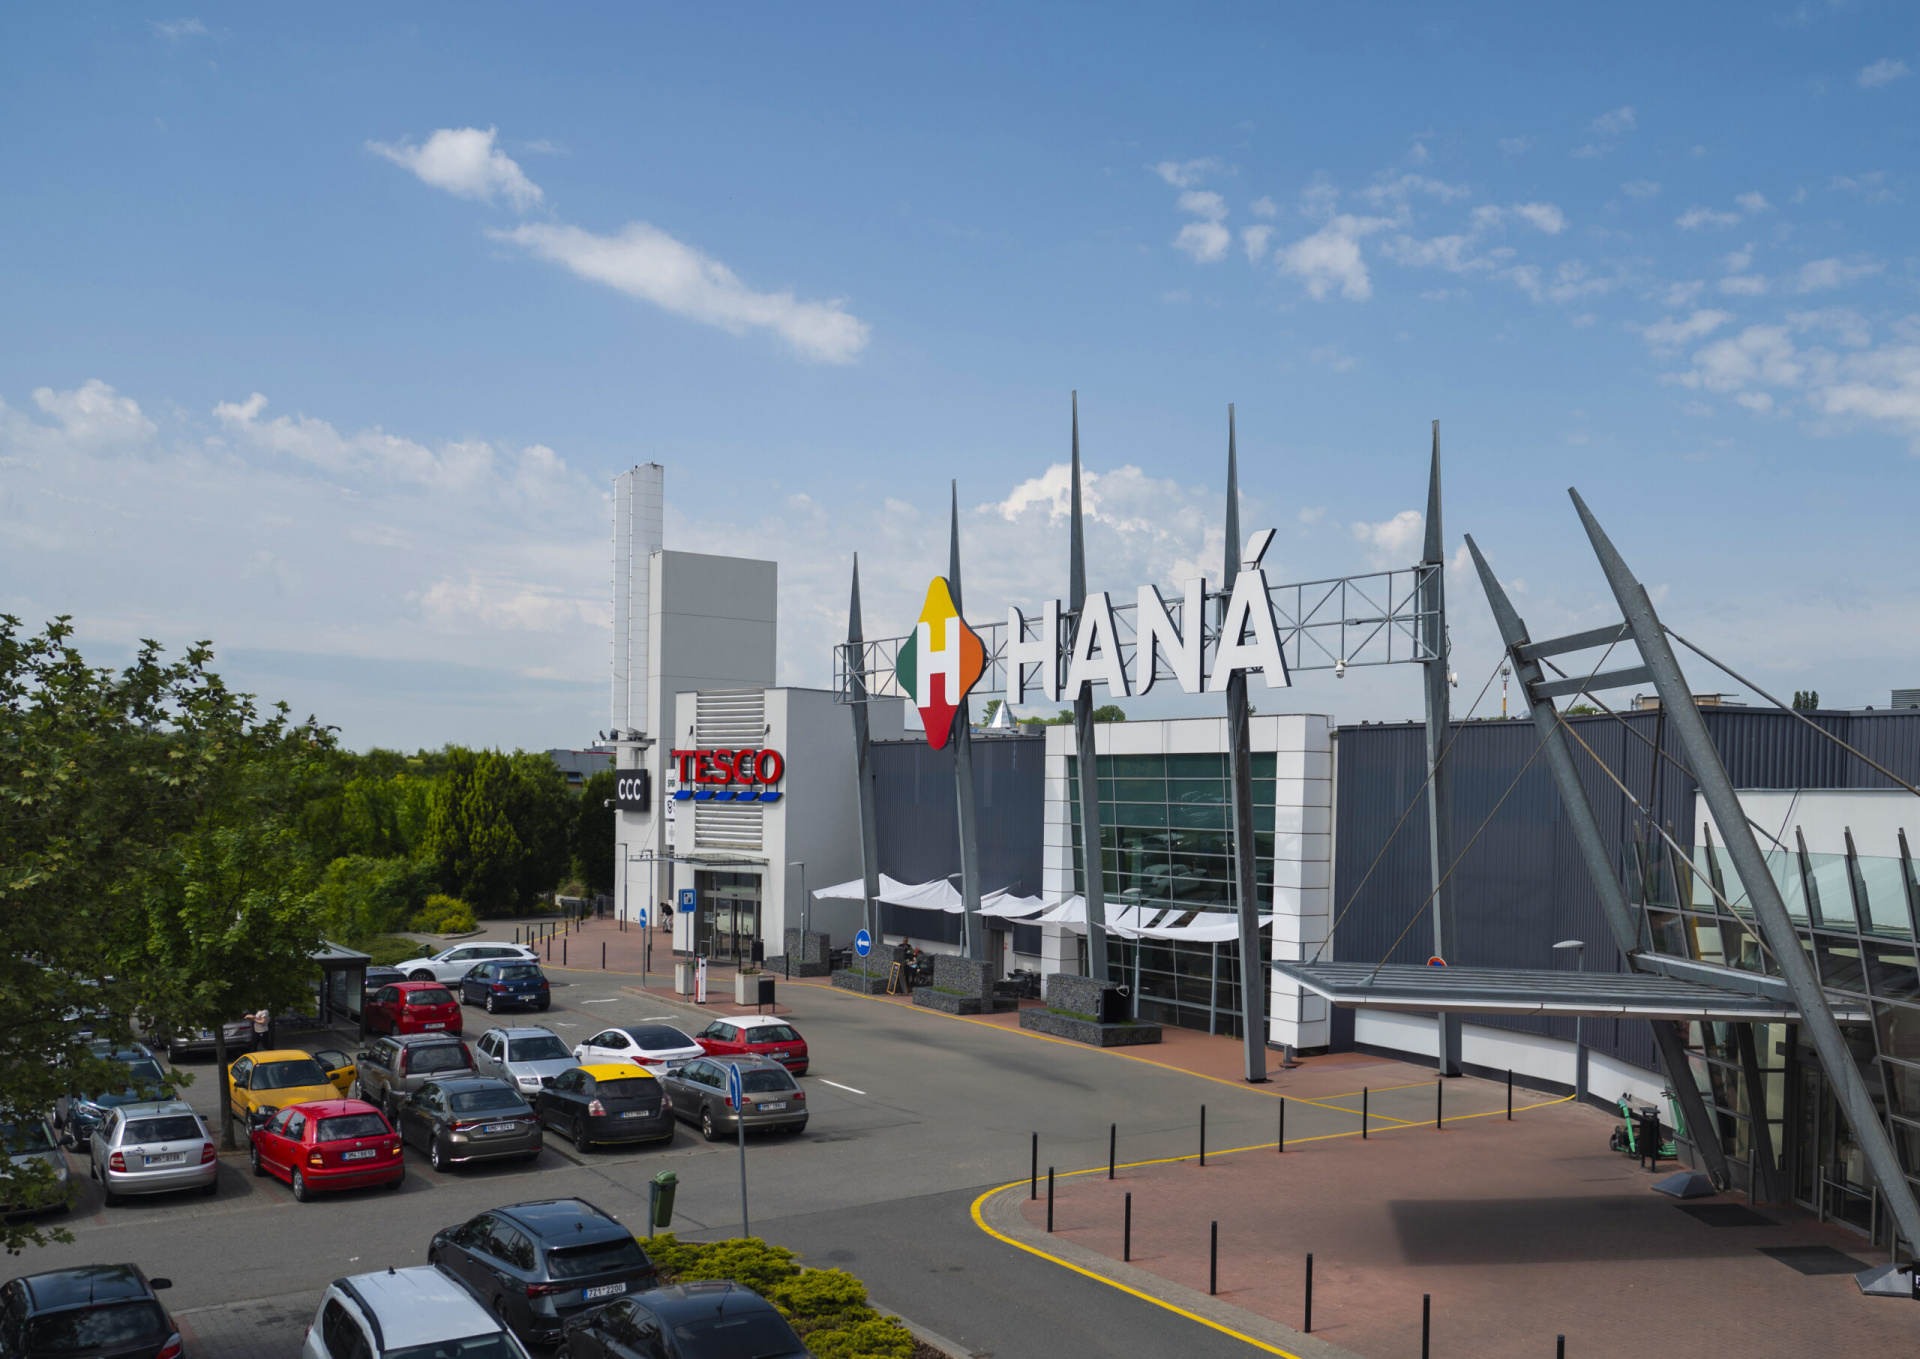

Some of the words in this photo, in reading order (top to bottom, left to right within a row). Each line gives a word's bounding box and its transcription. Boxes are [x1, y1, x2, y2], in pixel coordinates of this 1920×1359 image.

[1007, 528, 1291, 704] HANÁ
[917, 616, 961, 708] H
[672, 748, 785, 784] TESCO
[618, 778, 641, 801] CCC
[606, 1283, 623, 1294] 2200
